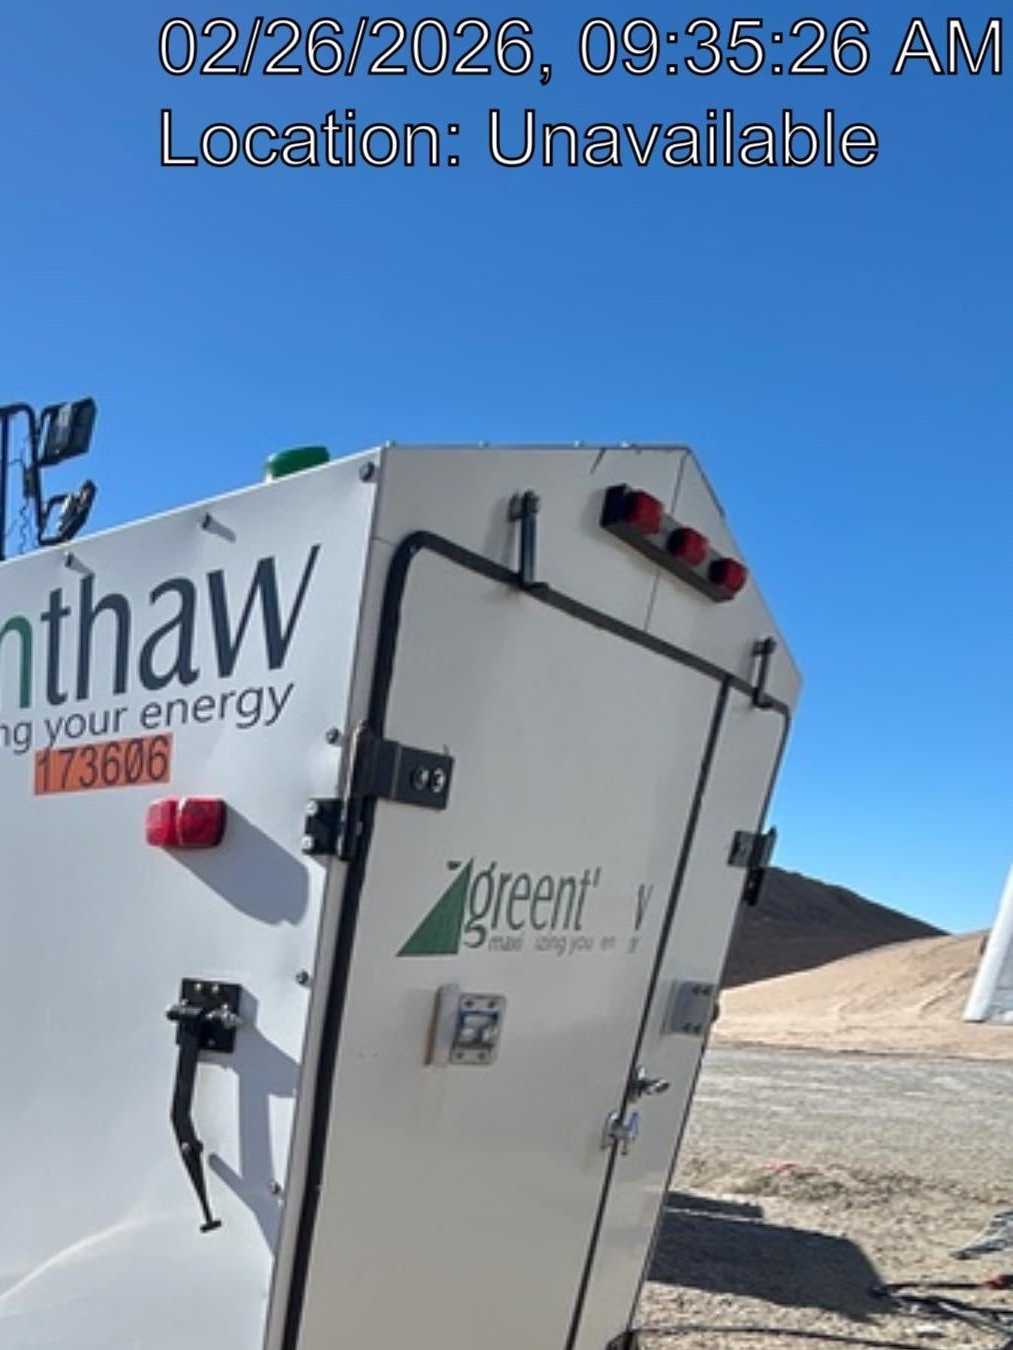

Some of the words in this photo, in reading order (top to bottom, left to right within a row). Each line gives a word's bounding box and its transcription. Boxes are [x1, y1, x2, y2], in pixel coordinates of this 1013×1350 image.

[44, 706, 128, 748] your
[140, 682, 295, 731] energy
[37, 736, 171, 788] 173606
